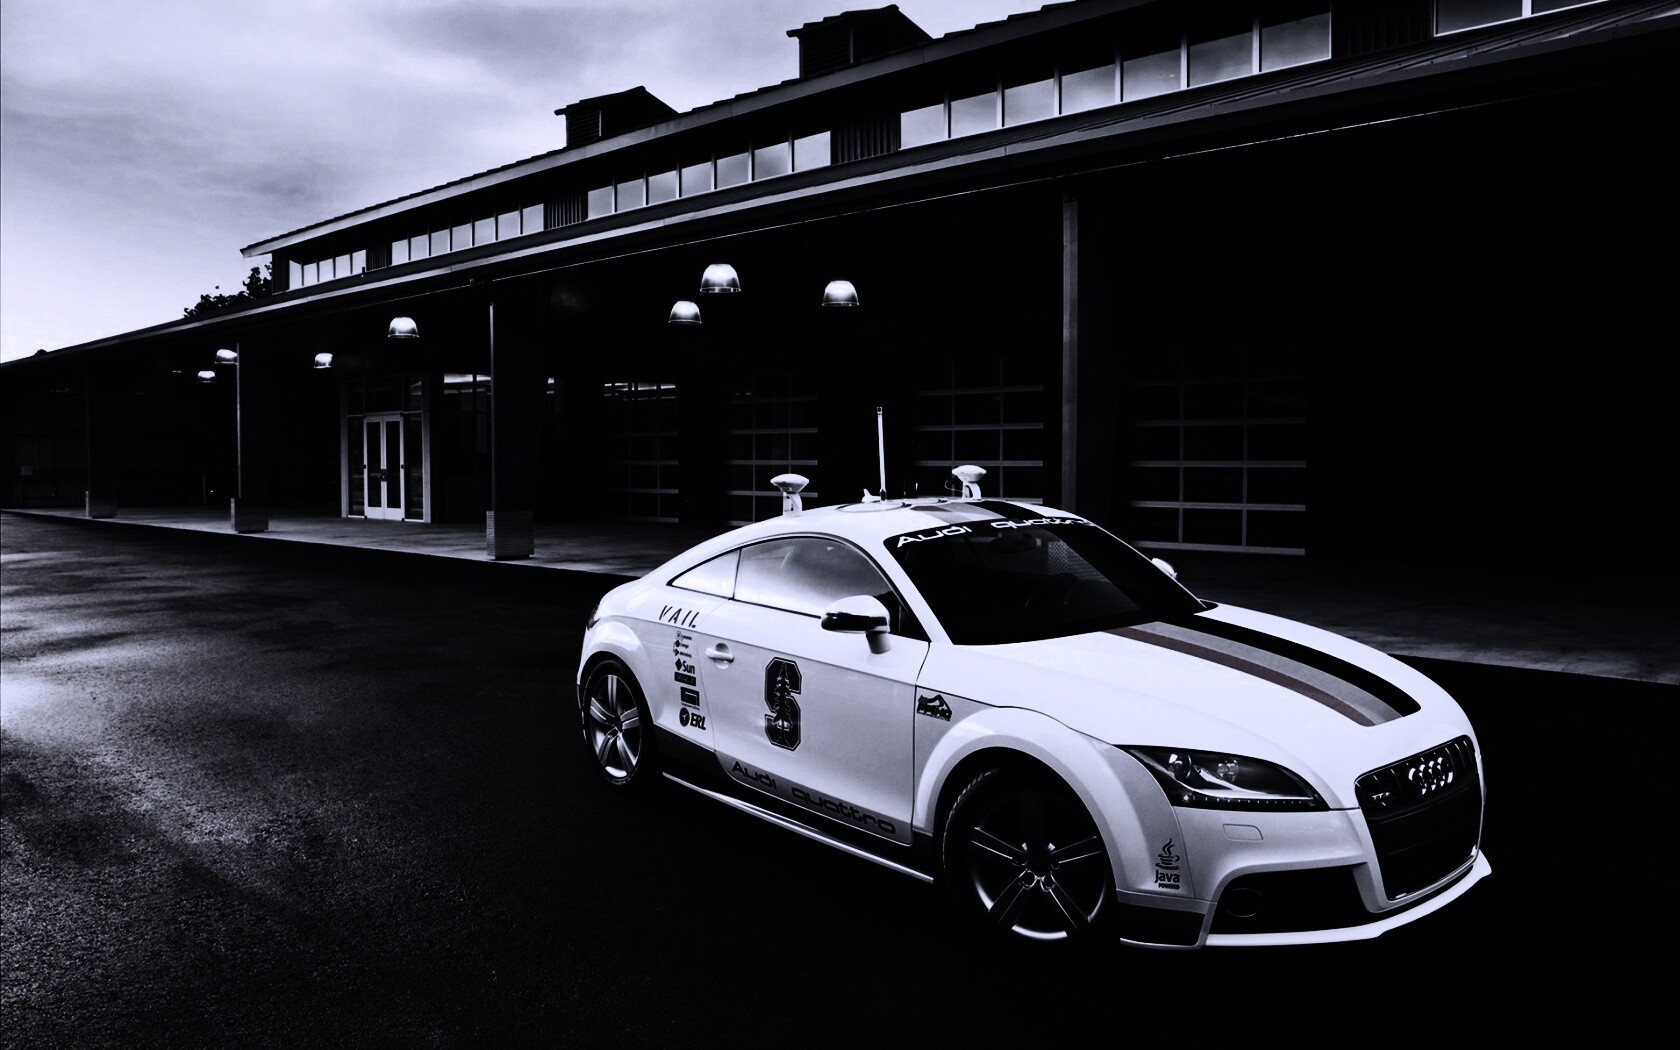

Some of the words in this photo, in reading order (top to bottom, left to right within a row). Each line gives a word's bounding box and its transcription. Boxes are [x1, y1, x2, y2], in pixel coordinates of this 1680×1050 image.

[896, 525, 973, 548] Audi
[659, 605, 700, 629] VAIL
[682, 660, 696, 675] Sun
[690, 712, 706, 731] ERL
[732, 761, 777, 790] Audi
[791, 787, 897, 835] quattro
[1154, 869, 1180, 884] Java
